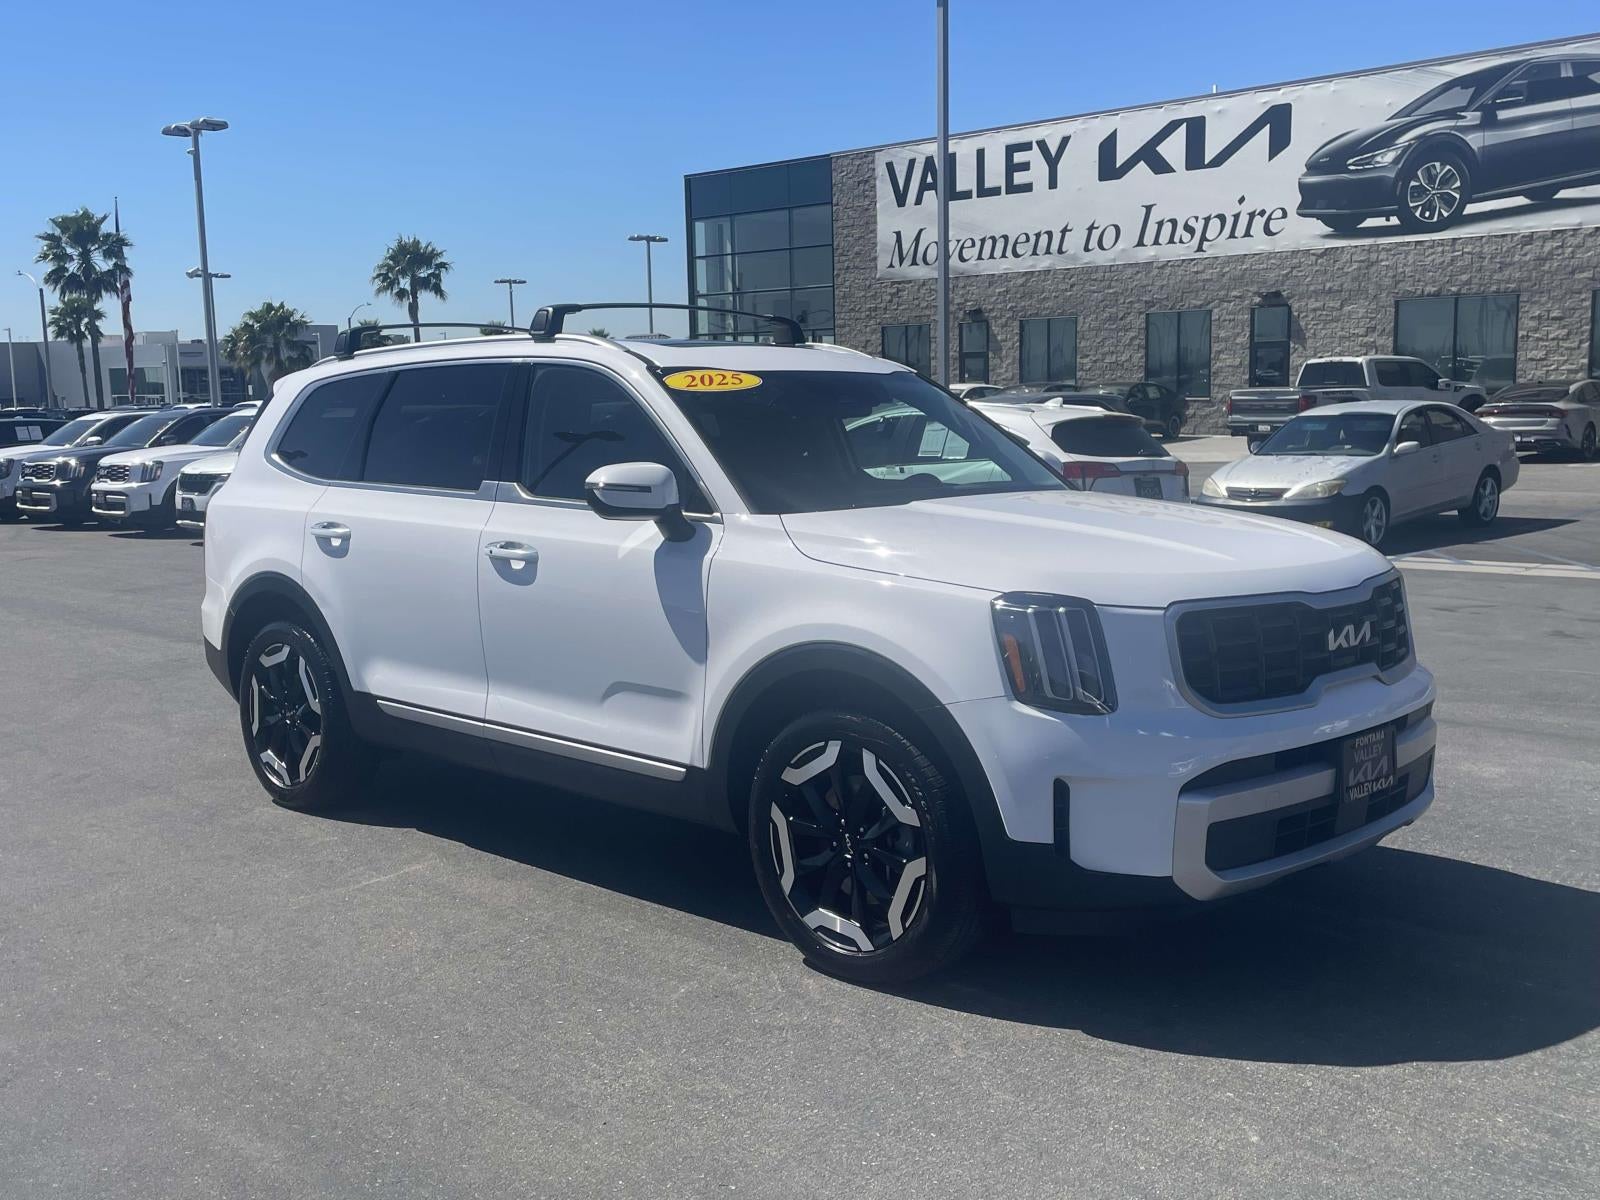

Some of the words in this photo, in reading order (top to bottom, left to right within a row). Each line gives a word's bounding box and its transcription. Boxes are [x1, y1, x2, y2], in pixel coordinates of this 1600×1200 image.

[885, 134, 1071, 208] VALLEY
[1098, 102, 1293, 182] KIA
[1083, 219, 1121, 253] to
[1132, 194, 1289, 253] Inspire
[683, 373, 743, 388] 2025
[1328, 620, 1371, 650] KIA
[1355, 729, 1385, 749] FONTANA
[1354, 743, 1383, 764] VALLEY
[1349, 755, 1388, 787] KIA
[1349, 780, 1373, 801] VALLEY
[1373, 775, 1393, 793] KIA
